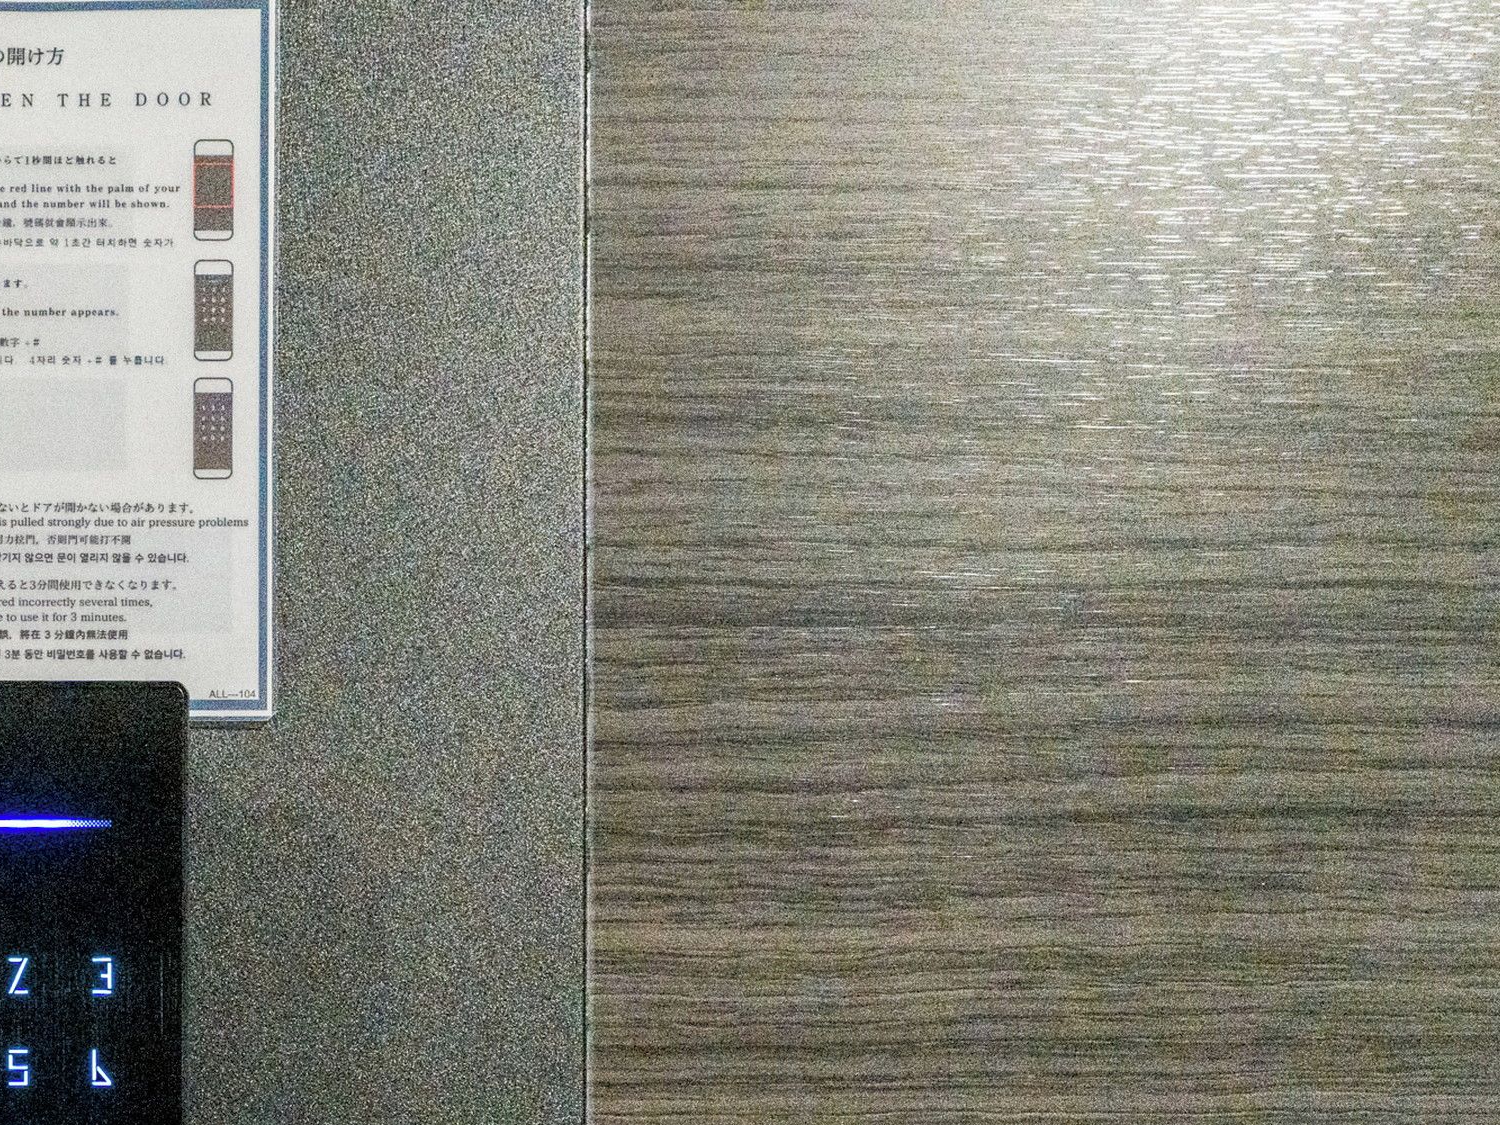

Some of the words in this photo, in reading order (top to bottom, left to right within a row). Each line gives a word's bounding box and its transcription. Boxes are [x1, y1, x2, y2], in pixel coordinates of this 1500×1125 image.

[57, 92, 112, 108] THE
[135, 91, 212, 107] DOOR
[10, 184, 27, 193] red
[31, 184, 52, 193] line
[57, 184, 81, 193] with
[86, 184, 103, 193] the
[107, 184, 134, 194] palm
[138, 184, 150, 193] of
[154, 186, 180, 194] your
[22, 200, 38, 208] the
[43, 199, 84, 208] number
[89, 199, 110, 208] will
[115, 199, 127, 208] be
[130, 199, 169, 208] shown.
[2, 307, 20, 317] the
[23, 307, 67, 317] number
[70, 309, 119, 318] appears.
[11, 517, 44, 528] pulled
[48, 517, 90, 528] strongly
[94, 517, 114, 527] due
[117, 519, 128, 527] to
[131, 518, 145, 527] air
[149, 519, 196, 529] pressure
[198, 517, 249, 529] problems
[24, 553, 53, 563] 않으면
[57, 553, 76, 563] 문이
[80, 553, 108, 563] 열리지
[112, 552, 131, 564] 않을
[135, 553, 144, 563] 수
[147, 552, 189, 564] 있습니다.
[19, 597, 76, 608] incorrectly
[79, 597, 117, 606] several
[121, 598, 153, 608] times,
[6, 614, 17, 622] to
[53, 613, 67, 621] for
[81, 614, 126, 622] minutes.
[5, 650, 20, 660] 3분
[24, 649, 43, 660] 동안
[47, 649, 95, 660] 비밀번호를
[99, 649, 128, 660] 사용할
[131, 649, 141, 660] 수
[143, 649, 186, 660] 없습니다.
[7, 956, 30, 996] 2
[91, 956, 115, 997] 3
[8, 1047, 31, 1088] 5
[90, 1049, 114, 1088] 6
